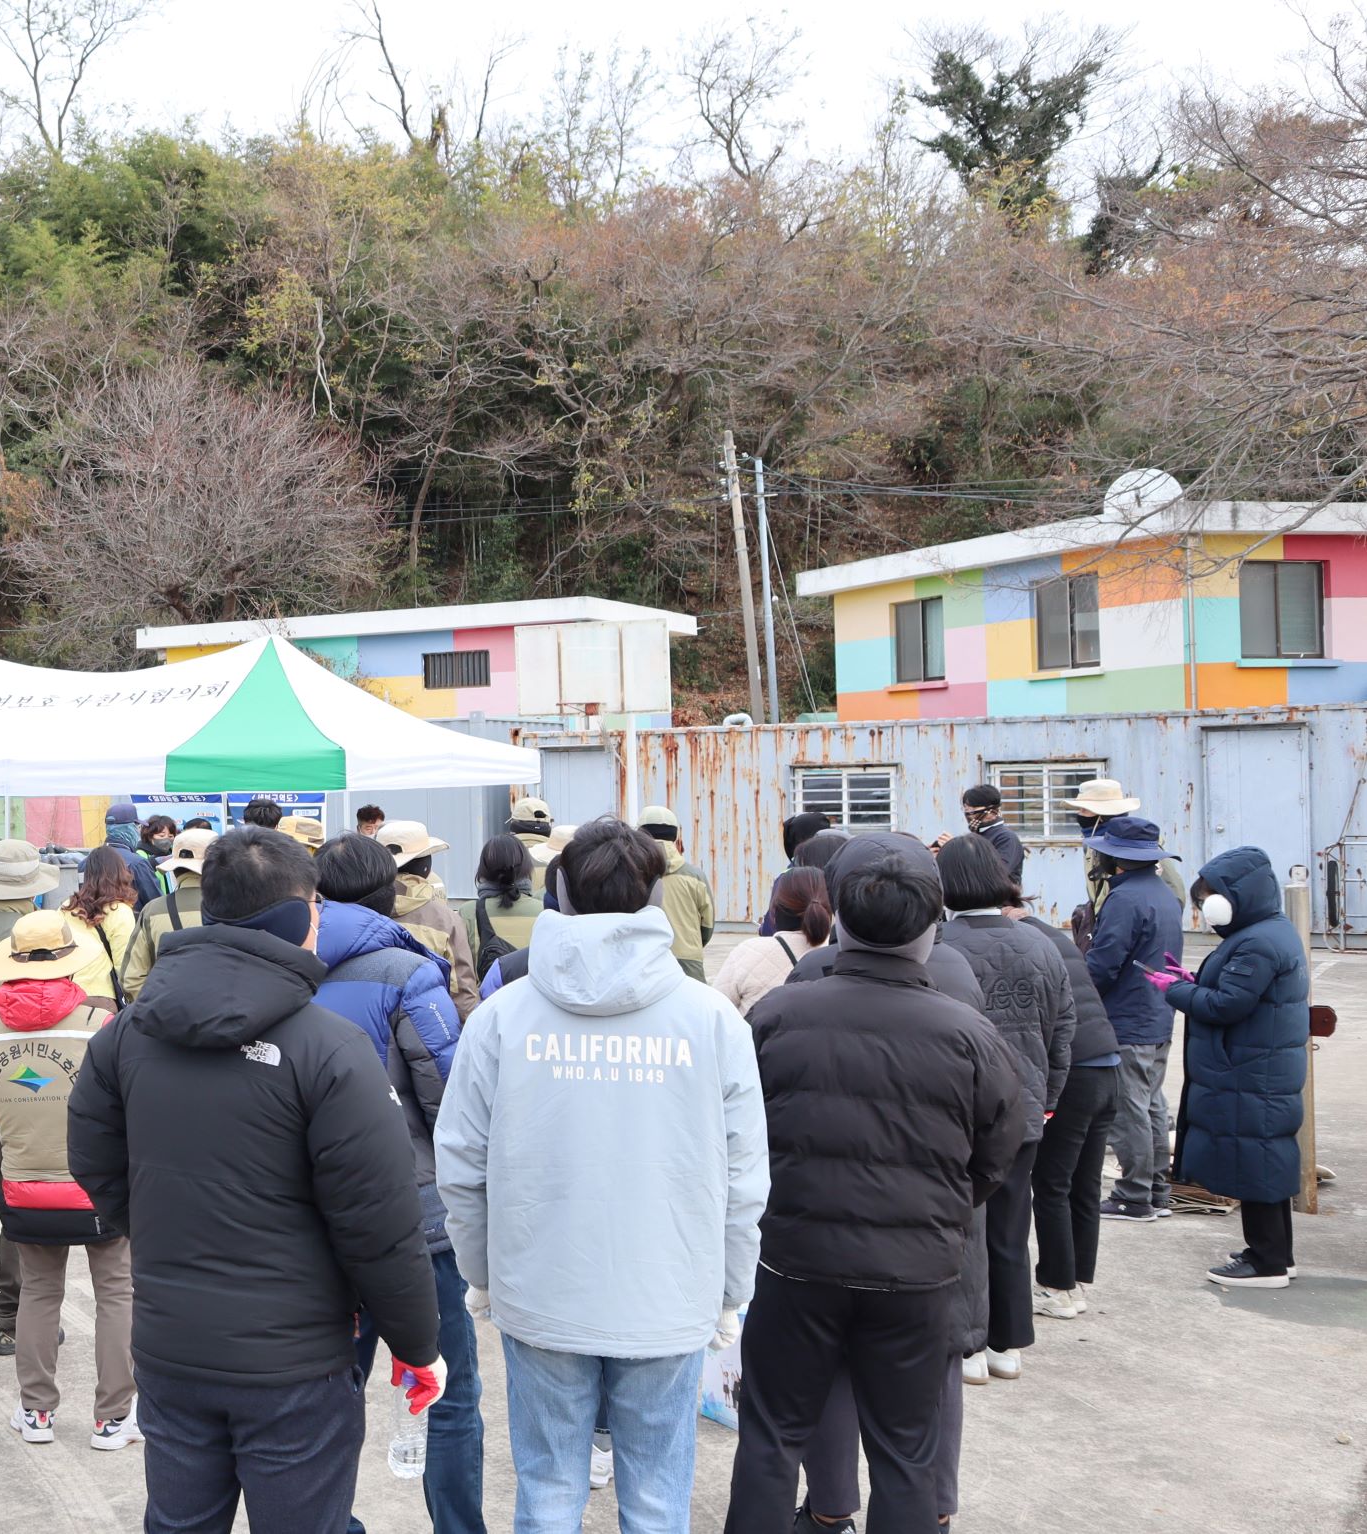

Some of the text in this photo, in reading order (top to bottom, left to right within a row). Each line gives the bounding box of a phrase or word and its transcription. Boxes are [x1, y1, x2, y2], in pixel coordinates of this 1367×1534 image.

[72, 680, 231, 708] 사천시협의회
[240, 1045, 269, 1056] NORTH
[526, 1033, 693, 1067] CALIFORNIA
[553, 1066, 665, 1084] WHO.A.U 1849
